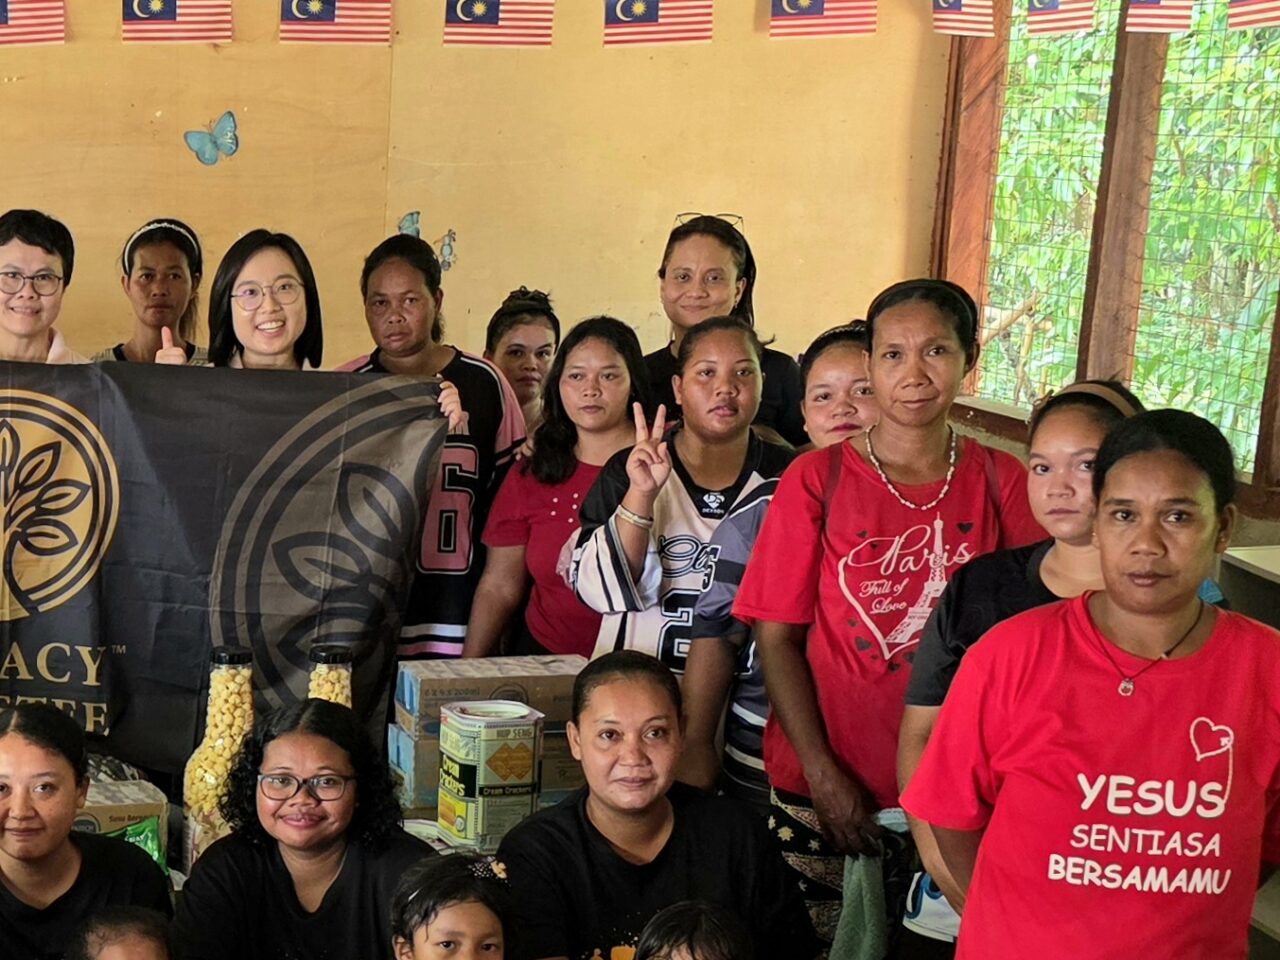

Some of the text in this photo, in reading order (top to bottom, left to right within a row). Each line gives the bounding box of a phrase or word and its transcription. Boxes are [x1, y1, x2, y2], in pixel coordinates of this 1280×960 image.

[847, 525, 976, 575] Paris
[859, 578, 910, 598] Full of
[870, 597, 908, 614] Love
[1077, 773, 1225, 818] YESUS
[1070, 824, 1221, 857] SENTIASA
[1048, 854, 1231, 894] BERSAMAMU
